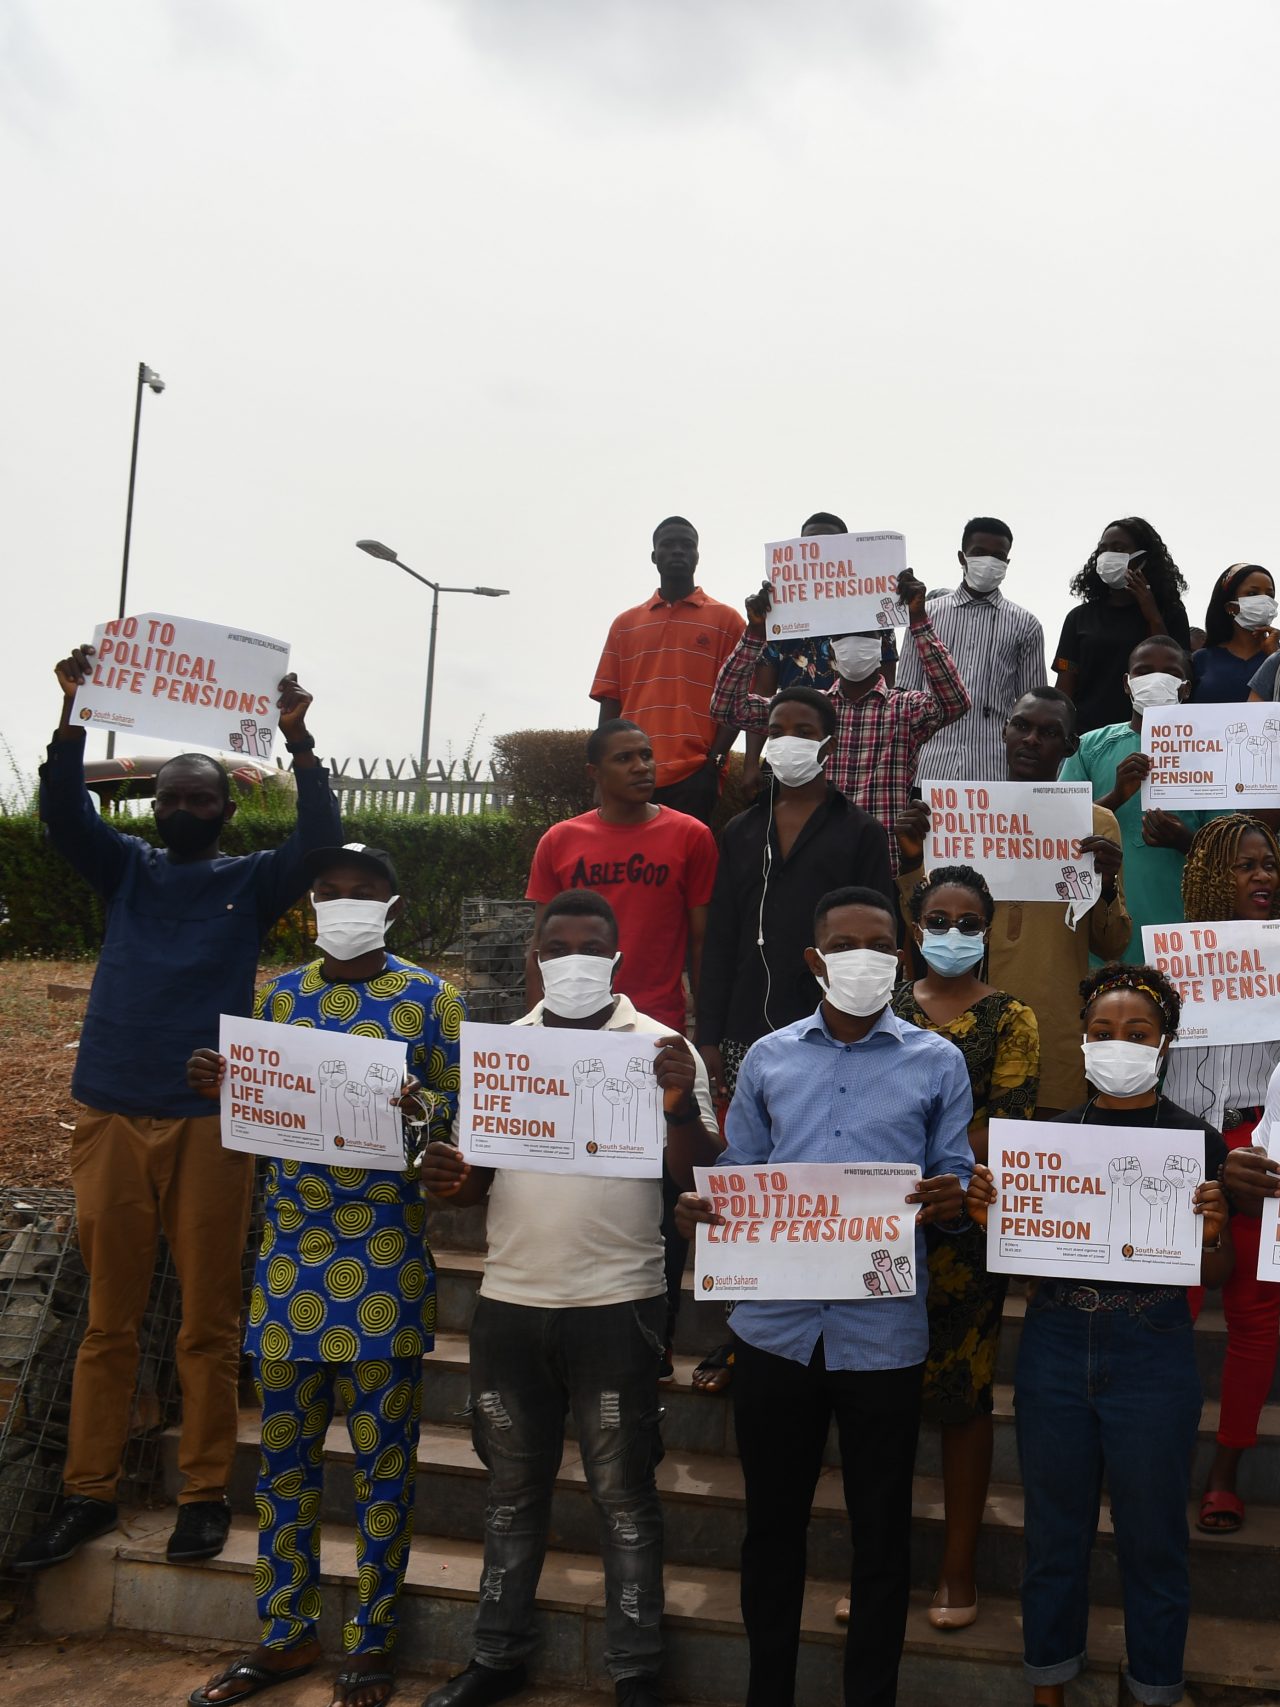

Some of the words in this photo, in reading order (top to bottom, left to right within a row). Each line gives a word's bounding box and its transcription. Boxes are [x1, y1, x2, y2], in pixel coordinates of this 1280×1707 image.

[773, 546, 793, 564] NO
[799, 542, 820, 560] TO
[771, 560, 857, 583] POLITICAL
[772, 584, 808, 605] LIFE
[814, 575, 898, 600] PENSIONS
[105, 617, 138, 639] NO
[148, 620, 176, 646] TO
[98, 639, 217, 683] POLITICAL
[92, 664, 145, 694] LIFE
[152, 676, 271, 716] PENSIONS
[1152, 726, 1171, 737] NO
[1174, 725, 1193, 737] TO
[1152, 740, 1223, 753] POLITICAL
[1151, 756, 1180, 768] LIFE
[1151, 771, 1213, 784] PENSION
[931, 788, 957, 809] NO
[965, 789, 989, 810] TO
[932, 813, 1034, 835] POLITICAL
[933, 837, 975, 859] LIFE
[983, 837, 1084, 861] PENSIONS
[1154, 932, 1183, 954] NO
[1190, 930, 1218, 950] TO
[1156, 949, 1266, 979] POLITICAL
[1177, 1028, 1186, 1036] uth
[1187, 1027, 1208, 1036] Saharan
[231, 1044, 254, 1061] NO
[258, 1049, 280, 1066] TO
[473, 1052, 501, 1069] NO
[505, 1053, 529, 1071] TO
[230, 1064, 316, 1094] POLITICAL
[474, 1073, 569, 1096] POLITICAL
[232, 1084, 264, 1104] LIFE
[474, 1094, 511, 1113] LIFE
[231, 1103, 306, 1129] PENSION
[473, 1115, 555, 1138] PENSION
[1002, 1151, 1030, 1170] NO
[1035, 1152, 1061, 1170] TO
[709, 1174, 745, 1194] NO
[754, 1172, 788, 1192] TO
[1002, 1174, 1106, 1195] POLITICAL
[713, 1194, 841, 1219] POLITICAL
[1002, 1195, 1043, 1214] LIFE
[708, 1220, 765, 1243] LIFE
[770, 1215, 901, 1243] PENSIONS
[1001, 1218, 1090, 1240] PENSION
[1135, 1246, 1154, 1254] South
[715, 1275, 733, 1285] South
[734, 1274, 758, 1285] Saharan
